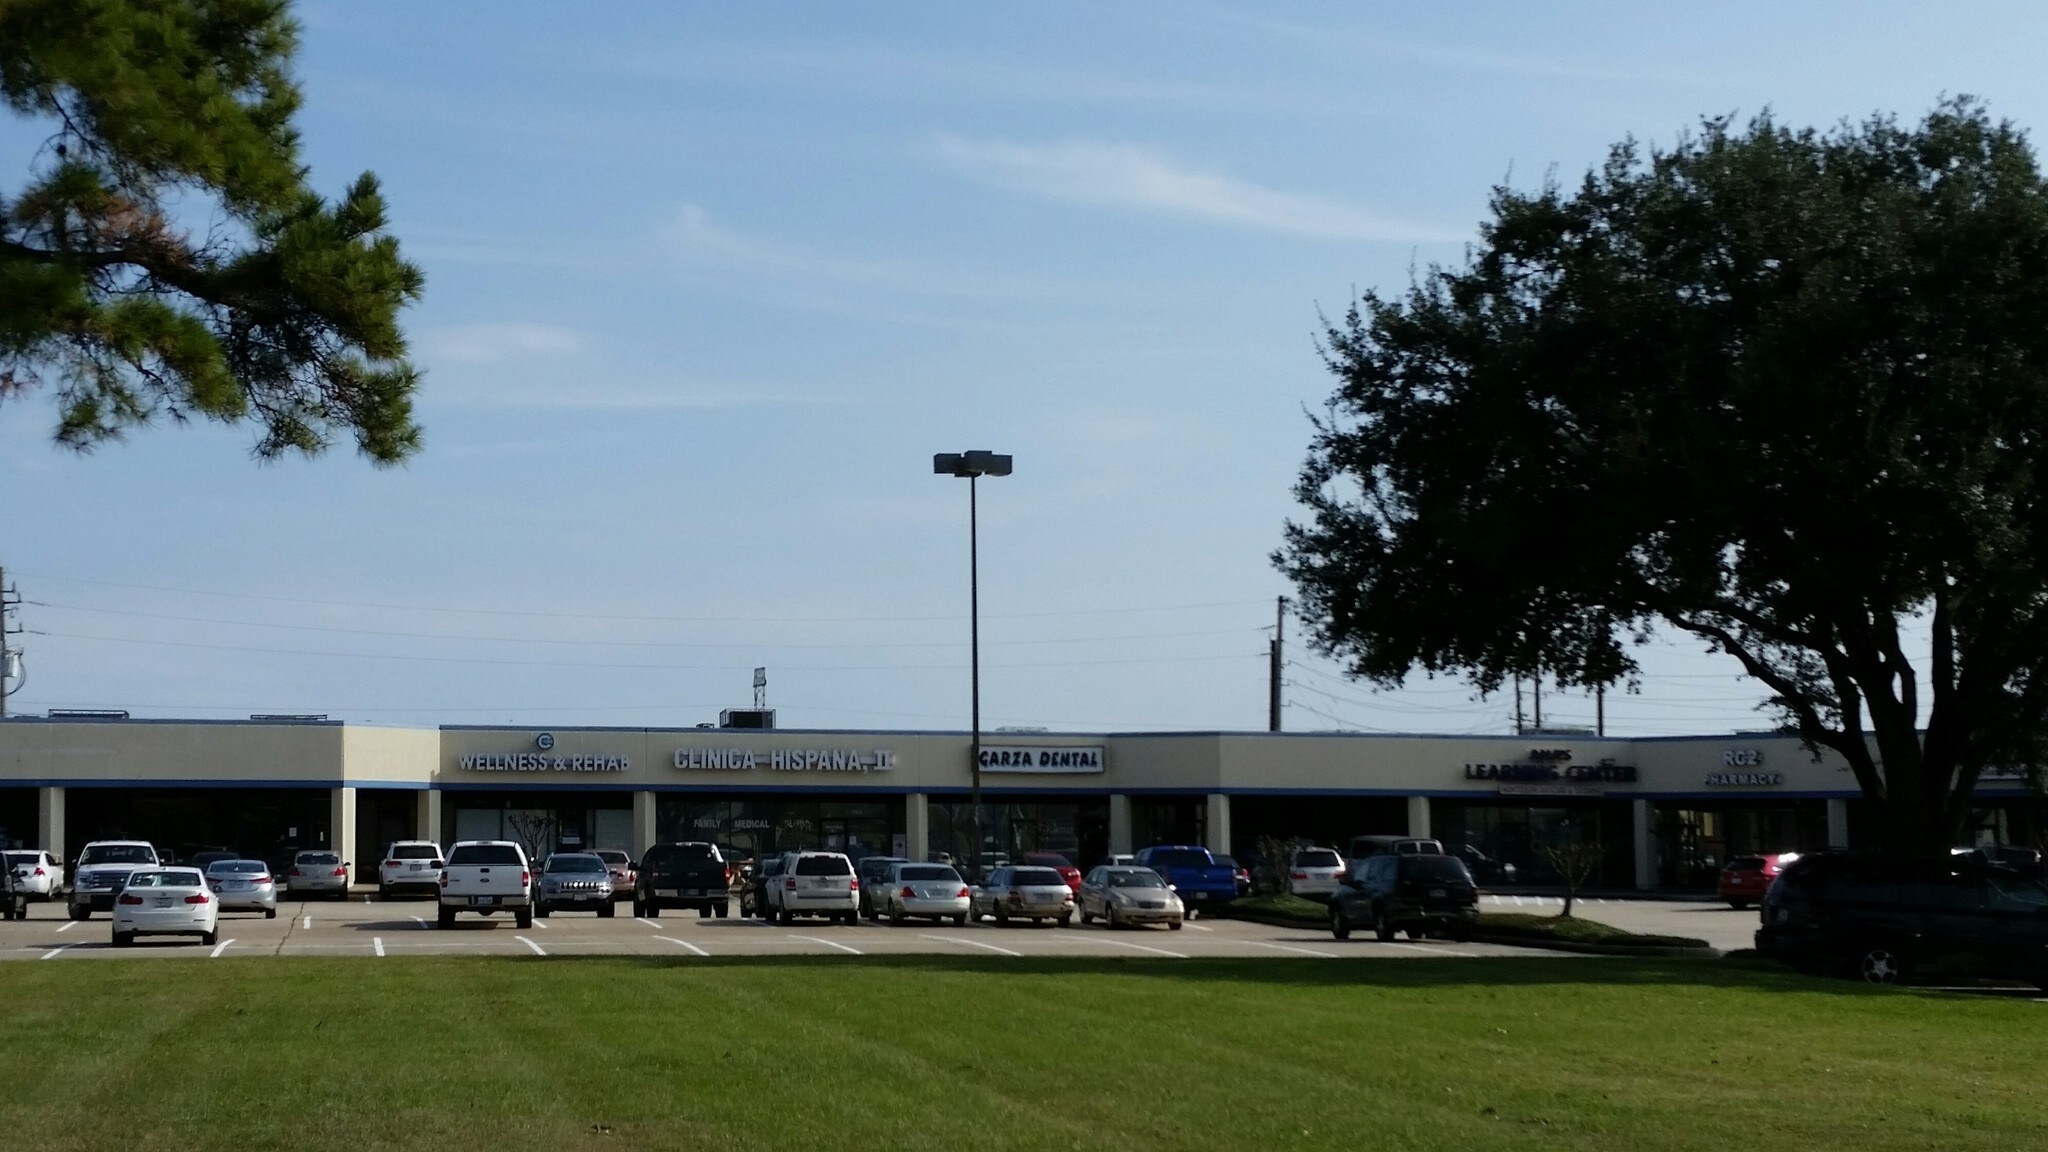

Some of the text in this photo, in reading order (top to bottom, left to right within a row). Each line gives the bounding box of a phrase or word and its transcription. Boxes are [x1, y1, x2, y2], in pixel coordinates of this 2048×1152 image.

[459, 753, 631, 772] WELLNESS & REHAB
[674, 747, 893, 773] CLINICA HISPANA, II
[979, 750, 1098, 768] GARZA DENTAL
[693, 818, 722, 829] FAMILY
[734, 819, 770, 829] MEDICAL
